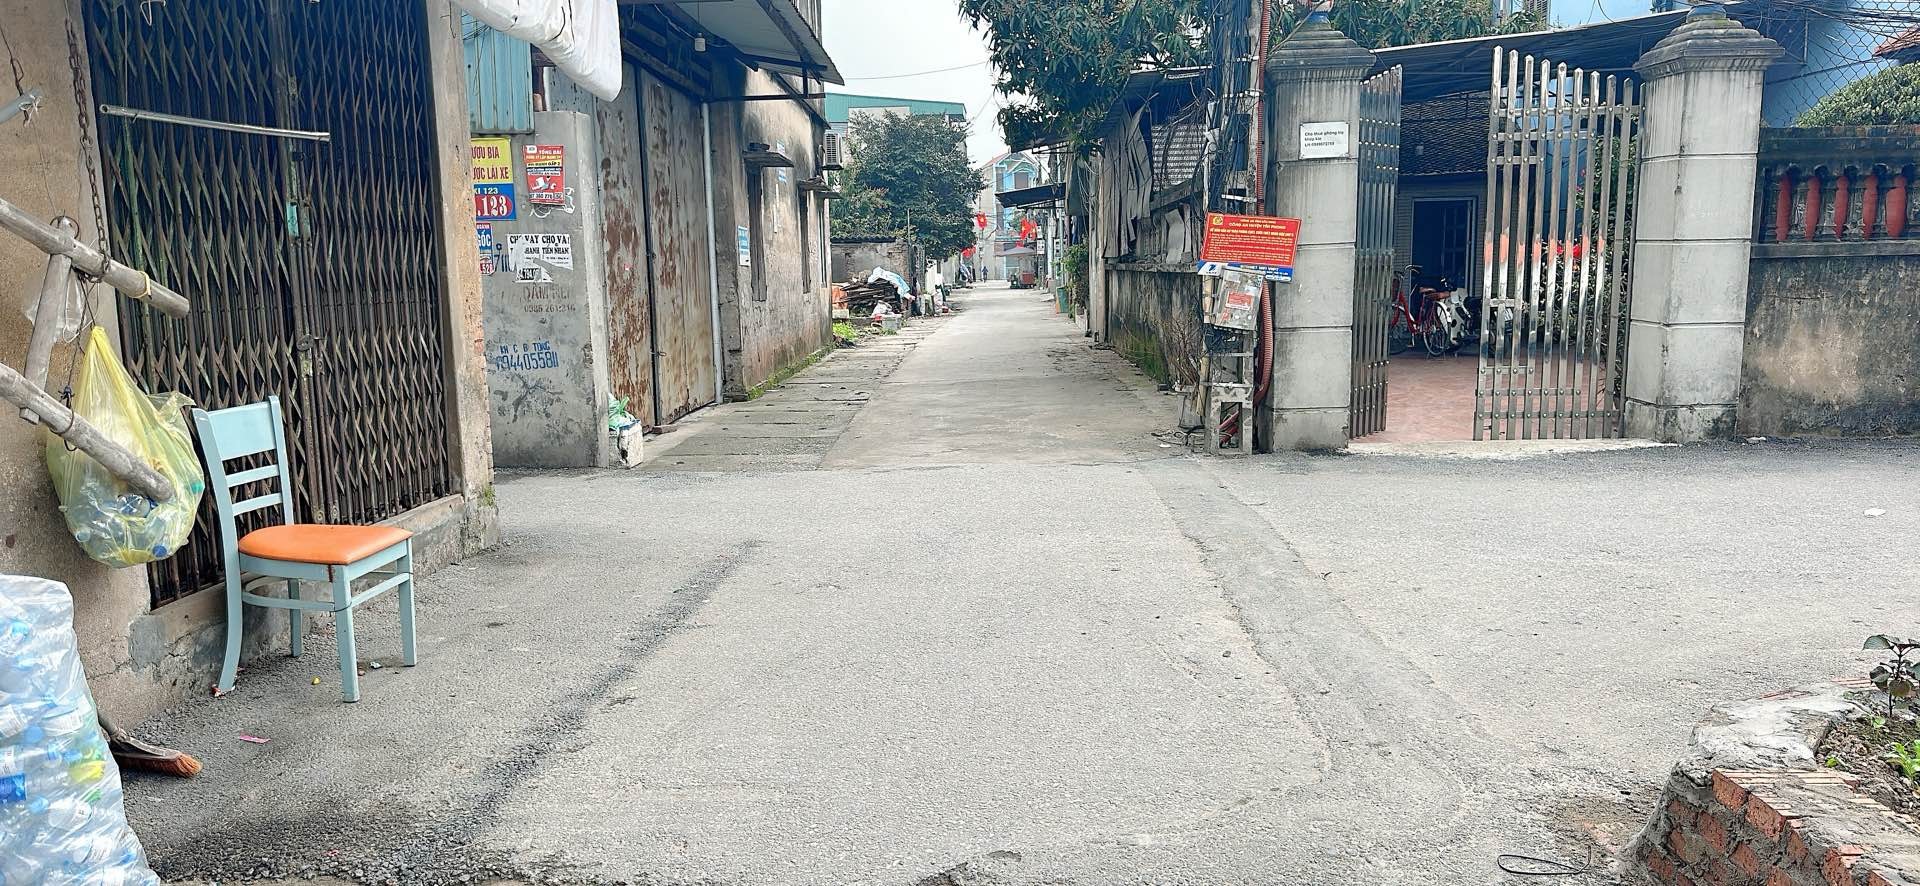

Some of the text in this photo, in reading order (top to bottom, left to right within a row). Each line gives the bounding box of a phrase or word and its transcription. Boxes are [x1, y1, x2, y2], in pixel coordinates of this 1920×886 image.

[472, 145, 500, 162] ƯỢU BIA
[473, 164, 510, 183] ƯỢC LÁI XE
[482, 187, 498, 195] 123
[509, 234, 522, 244] CH
[524, 234, 539, 244] VAY
[556, 234, 570, 244] VA
